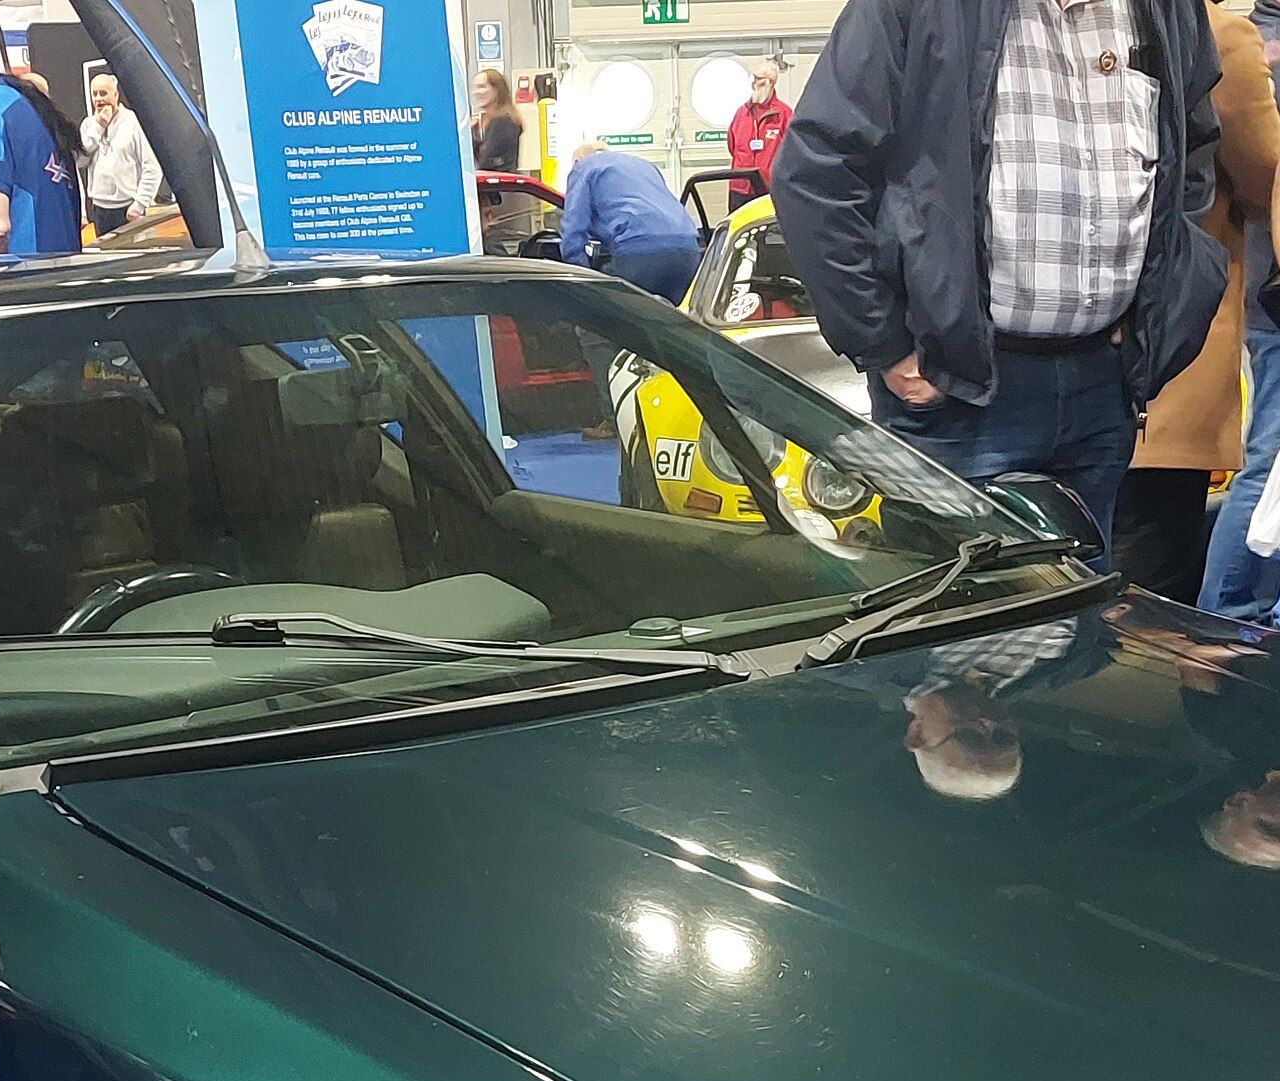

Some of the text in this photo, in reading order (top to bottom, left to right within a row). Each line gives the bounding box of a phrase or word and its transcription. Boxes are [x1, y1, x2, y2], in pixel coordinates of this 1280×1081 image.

[283, 107, 422, 127] CLUB ALPINE RENAULT
[656, 443, 694, 477] elf
